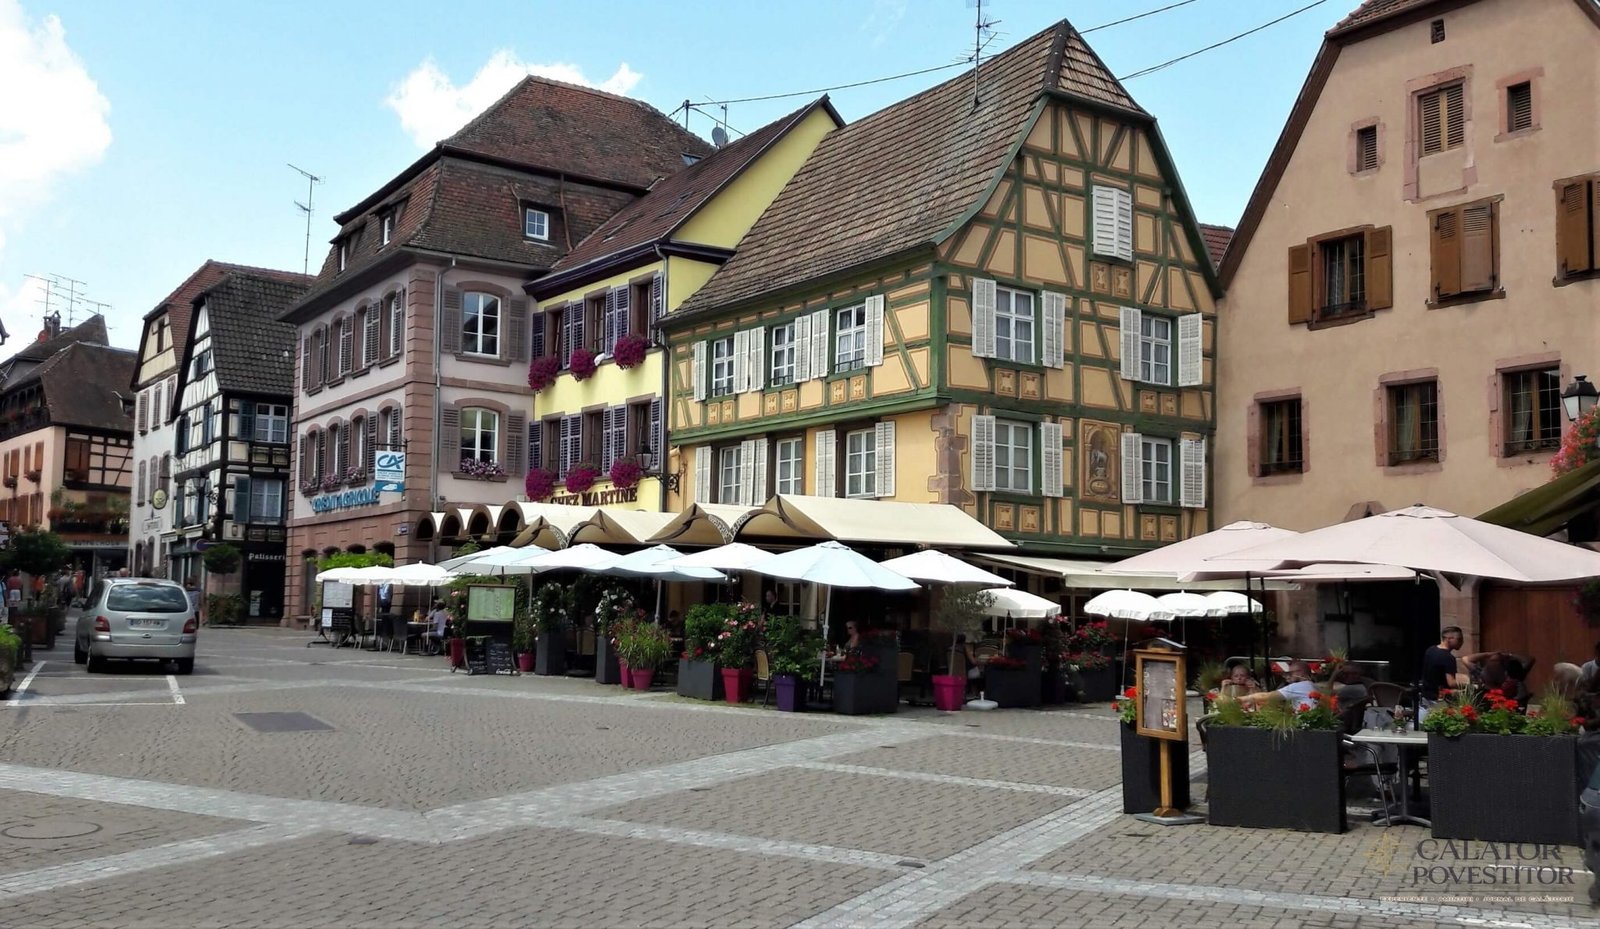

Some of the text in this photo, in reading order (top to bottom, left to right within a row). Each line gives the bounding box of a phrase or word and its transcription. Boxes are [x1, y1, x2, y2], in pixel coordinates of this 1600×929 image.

[550, 487, 638, 507] CHEZ MARTINE
[249, 552, 285, 561] Patisseri
